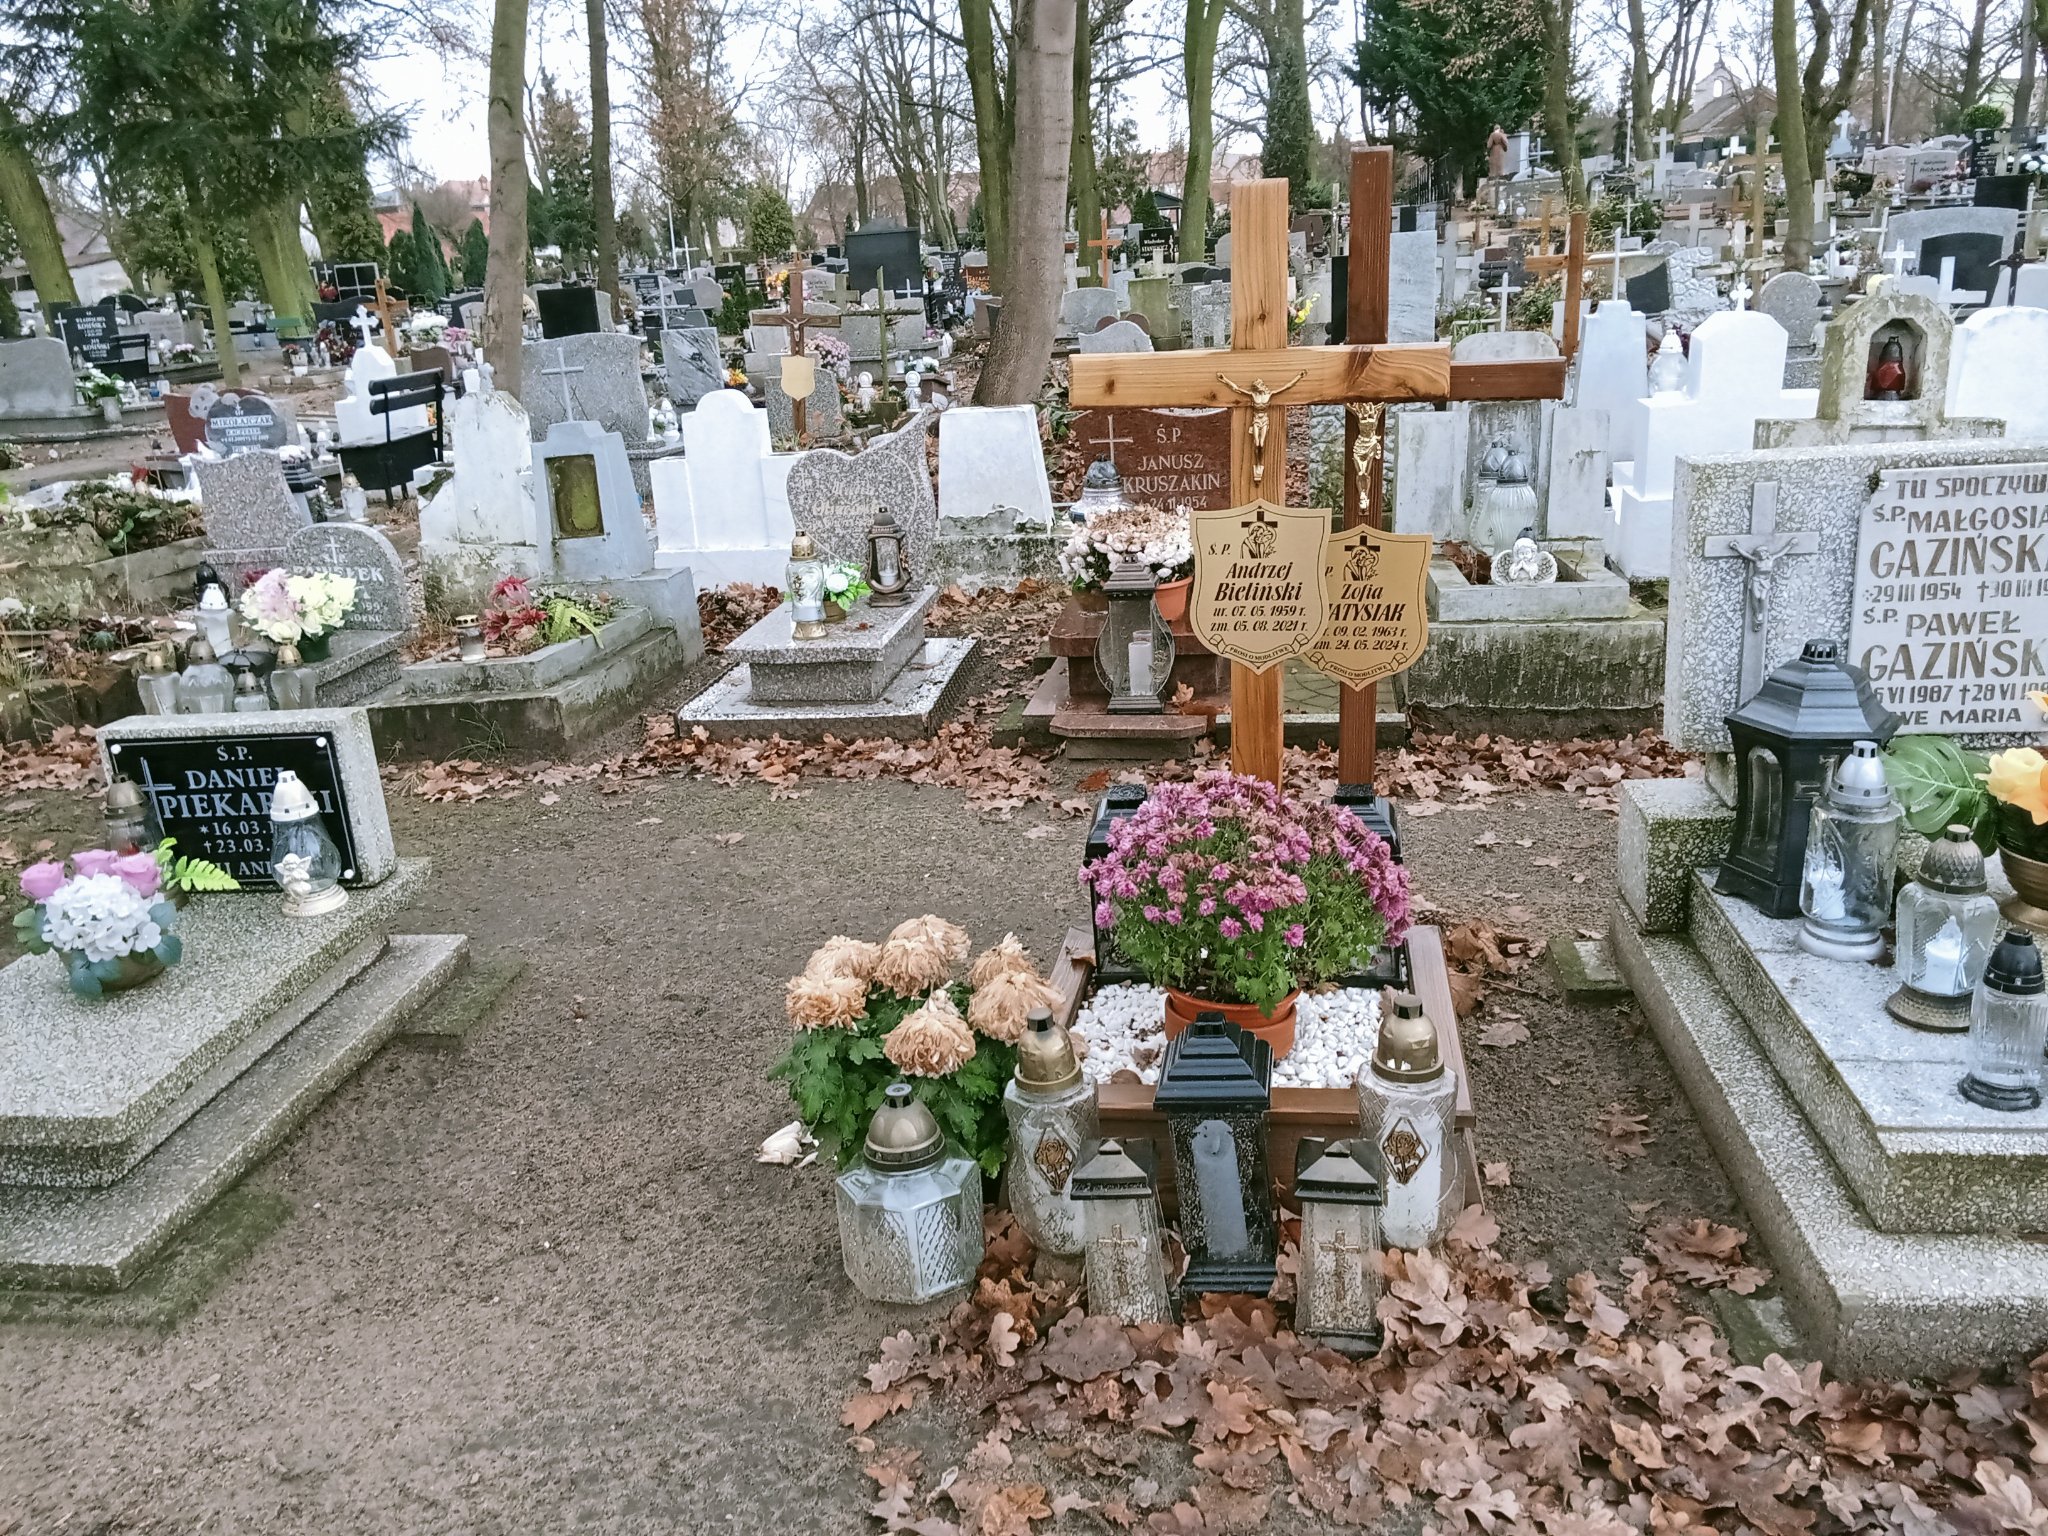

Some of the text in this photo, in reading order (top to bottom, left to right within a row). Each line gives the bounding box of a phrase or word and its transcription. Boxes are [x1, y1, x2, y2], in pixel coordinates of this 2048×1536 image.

[1138, 453, 1204, 471] JANUSZ
[1121, 473, 1221, 495] KRUSZAKIN
[1896, 473, 2048, 500] TU SPOCZYW
[1869, 533, 2048, 579] GAZIŃSK
[1225, 561, 1294, 581] Andrzej
[1214, 582, 1303, 601] Bieliński
[1341, 584, 1384, 602] Zofia
[1920, 582, 1961, 602] 1954
[1213, 605, 1306, 617] ur. 07. 05. 1959 r.
[1329, 603, 1406, 621] ATYSIAK
[1210, 620, 1308, 632] zm. 05. 08. 2021 r.
[1333, 626, 1349, 637] 09.
[1352, 626, 1368, 637] 02.
[1371, 626, 1398, 637] 1963
[1400, 628, 1407, 637] r.
[1905, 610, 2021, 638] PAWEŁ
[1335, 640, 1350, 650] 24.
[1354, 640, 1369, 650] 05.
[1372, 640, 1400, 650] 2024
[1401, 642, 1408, 650] r.
[1887, 686, 1905, 704] VI
[1909, 685, 1954, 704] 1987
[1999, 682, 2017, 701] VI
[1891, 707, 2021, 726] VE MARIA
[158, 790, 334, 819] PIEKARI
